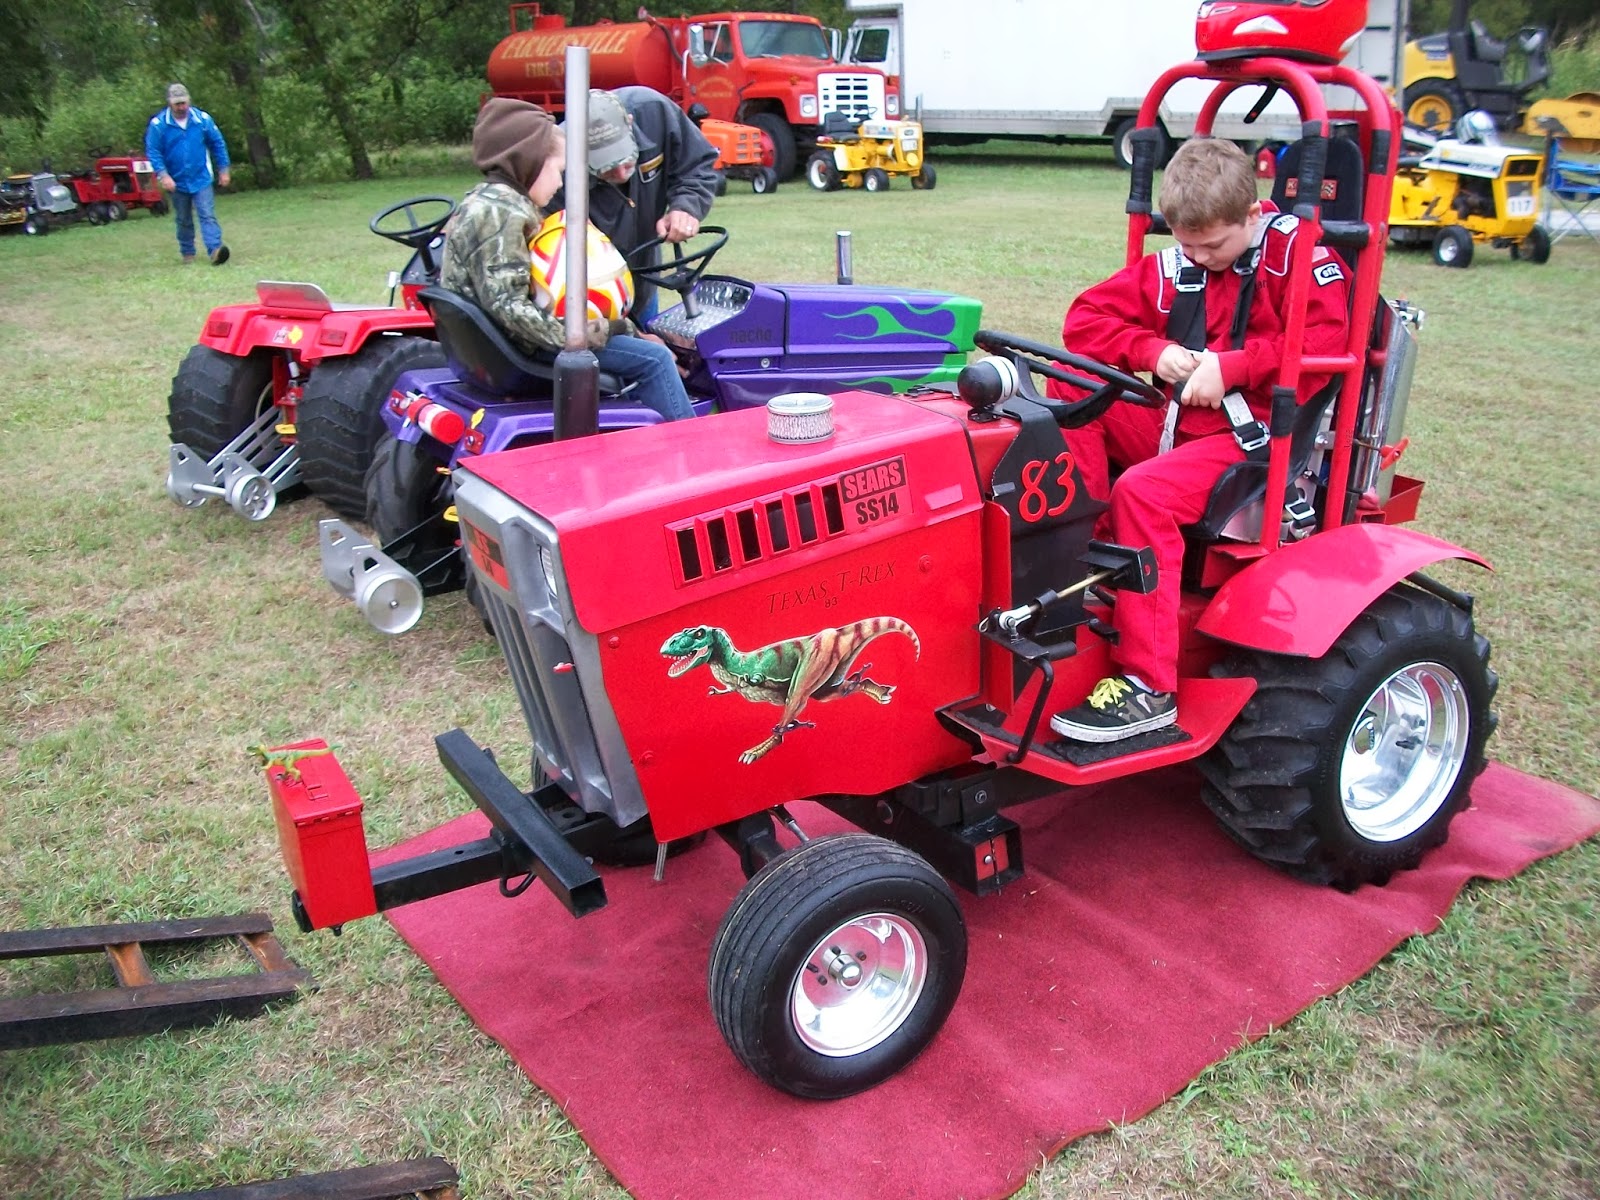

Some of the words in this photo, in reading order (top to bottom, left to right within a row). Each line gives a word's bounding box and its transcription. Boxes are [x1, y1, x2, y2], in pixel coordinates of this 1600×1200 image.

[1511, 199, 1531, 213] 117
[843, 461, 902, 499] SEARS
[1019, 451, 1076, 523] 83
[855, 491, 900, 525] SS14
[767, 580, 829, 615] TEXAS
[836, 560, 897, 593] T-REX
[824, 596, 838, 609] 83
